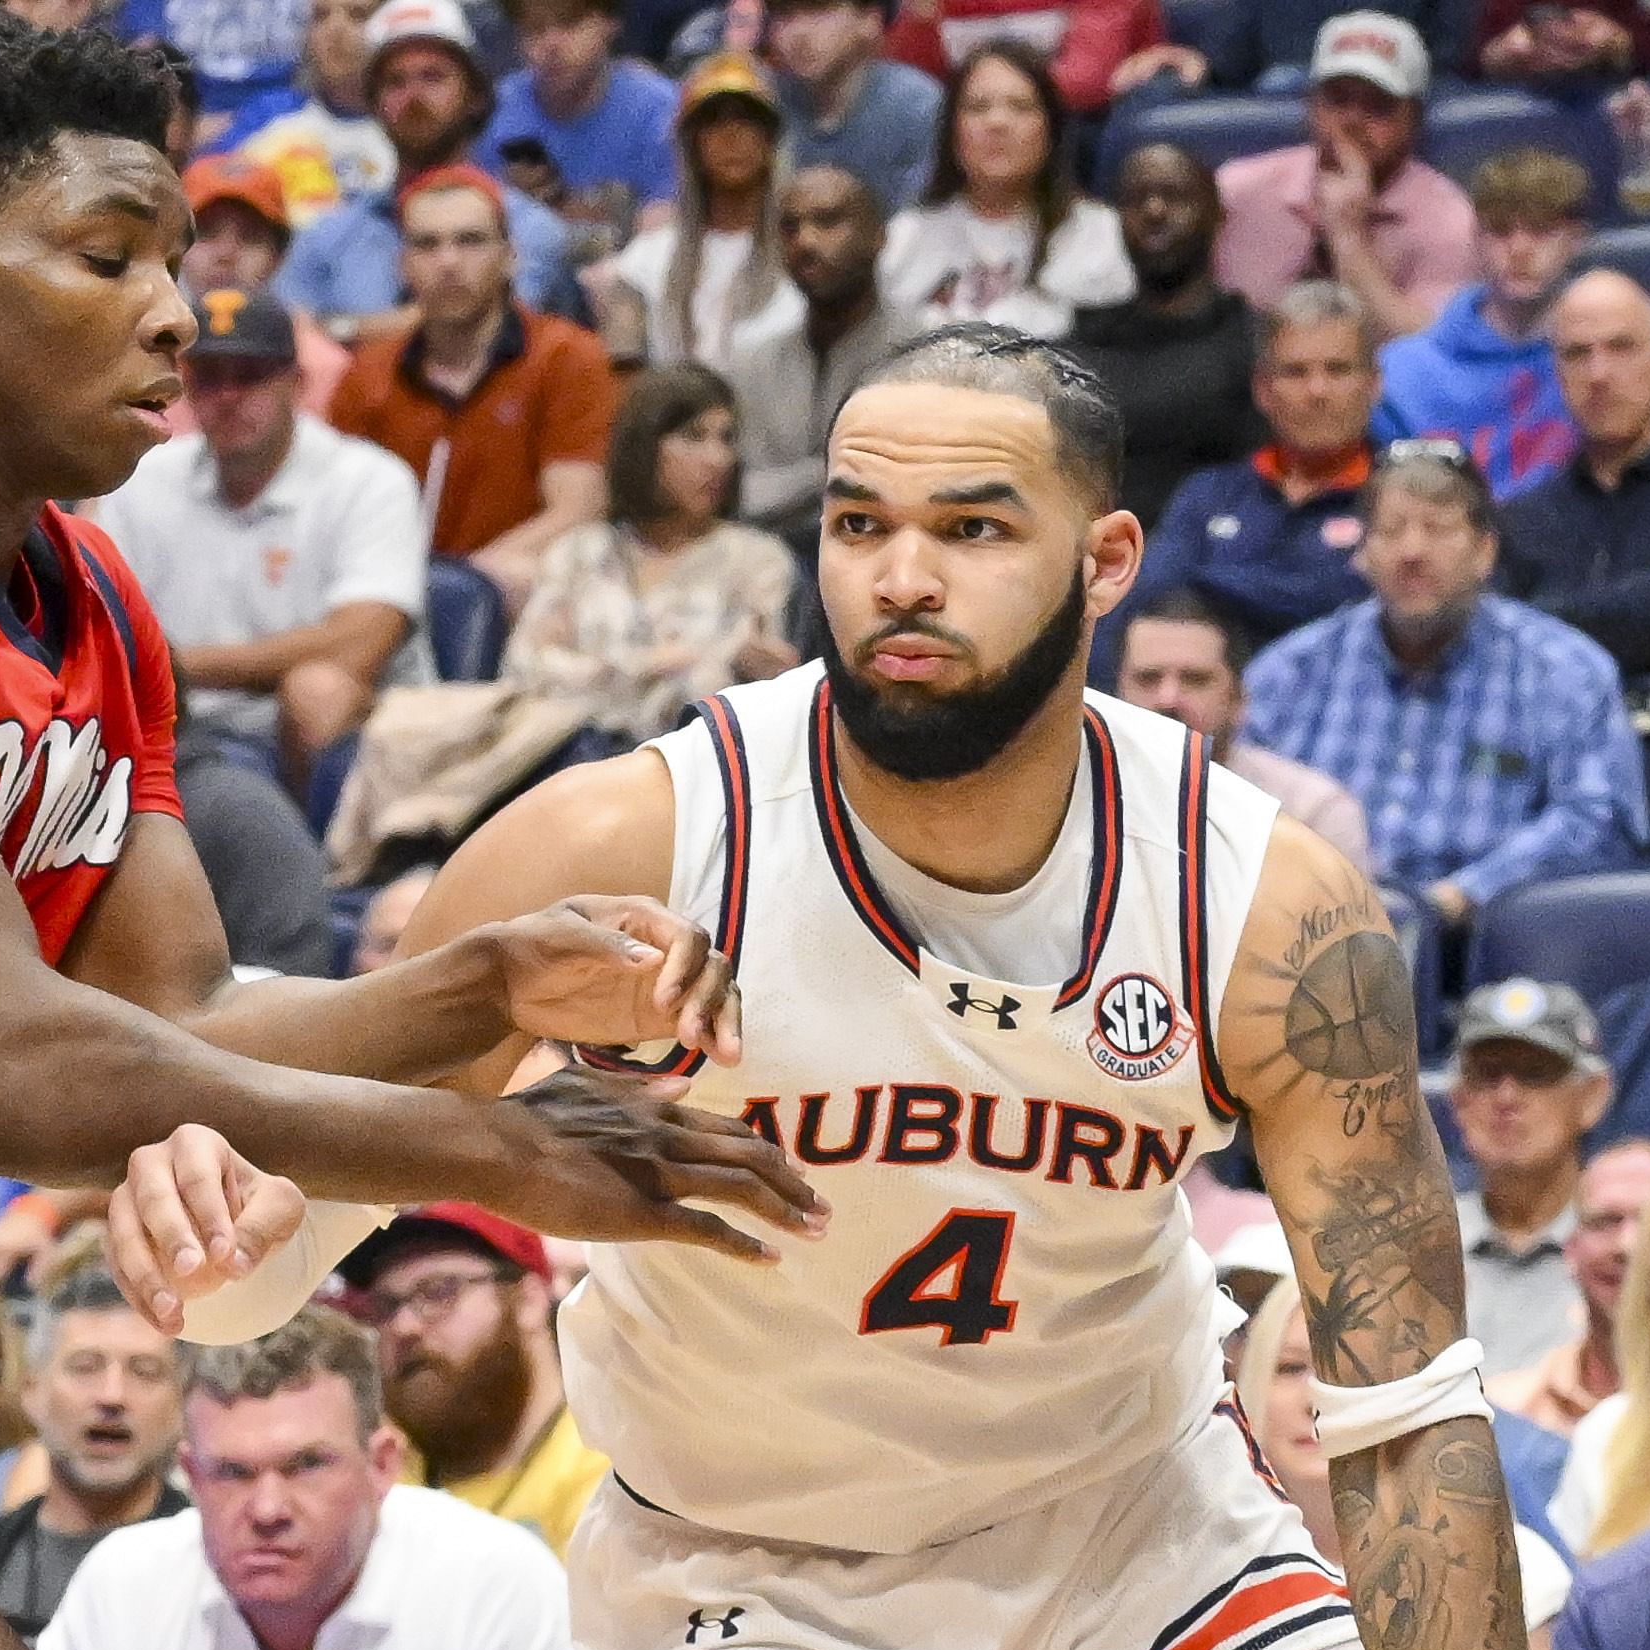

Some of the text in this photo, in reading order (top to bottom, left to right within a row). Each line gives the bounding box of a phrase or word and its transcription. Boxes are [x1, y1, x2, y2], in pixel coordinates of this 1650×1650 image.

[1096, 1045, 1179, 1078] GRADUATE
[1101, 979, 1169, 1053] SEC
[738, 1083, 1197, 1191] AUBURN
[857, 1207, 1019, 1348] 4
